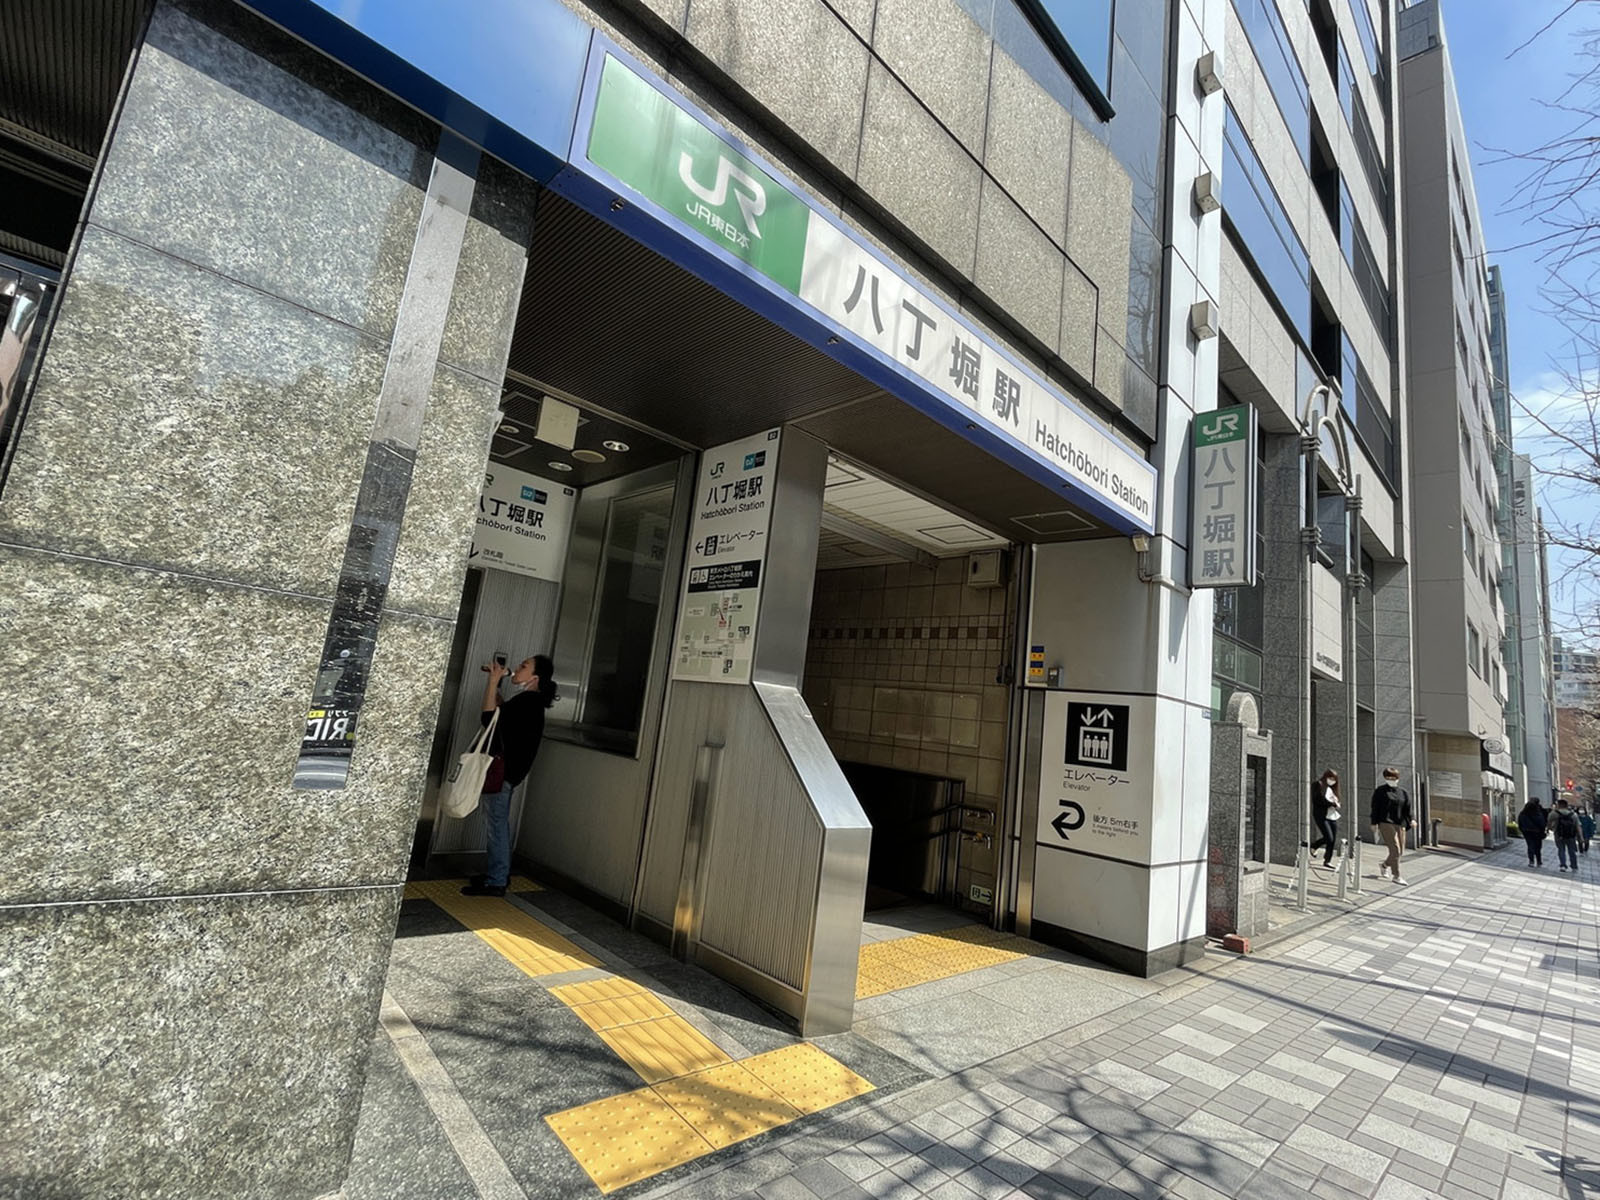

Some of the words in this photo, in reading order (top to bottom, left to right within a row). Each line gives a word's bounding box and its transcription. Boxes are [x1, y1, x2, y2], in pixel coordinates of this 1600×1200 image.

[678, 151, 766, 239] JR
[686, 201, 749, 249] JR東日本
[843, 264, 1021, 428] 八丁堀駅
[1203, 413, 1239, 435] JR
[710, 462, 724, 475] JR
[1035, 419, 1109, 487] Hatchōbori
[1111, 473, 1149, 516] Station
[706, 475, 763, 506] 八丁堀駅
[738, 500, 765, 513] Station
[1202, 447, 1236, 578] 八丁堀駅
[514, 526, 546, 541] Station
[719, 529, 764, 545] エレベーター
[1063, 768, 1130, 786] エレベーター
[1063, 781, 1091, 792] Elevator
